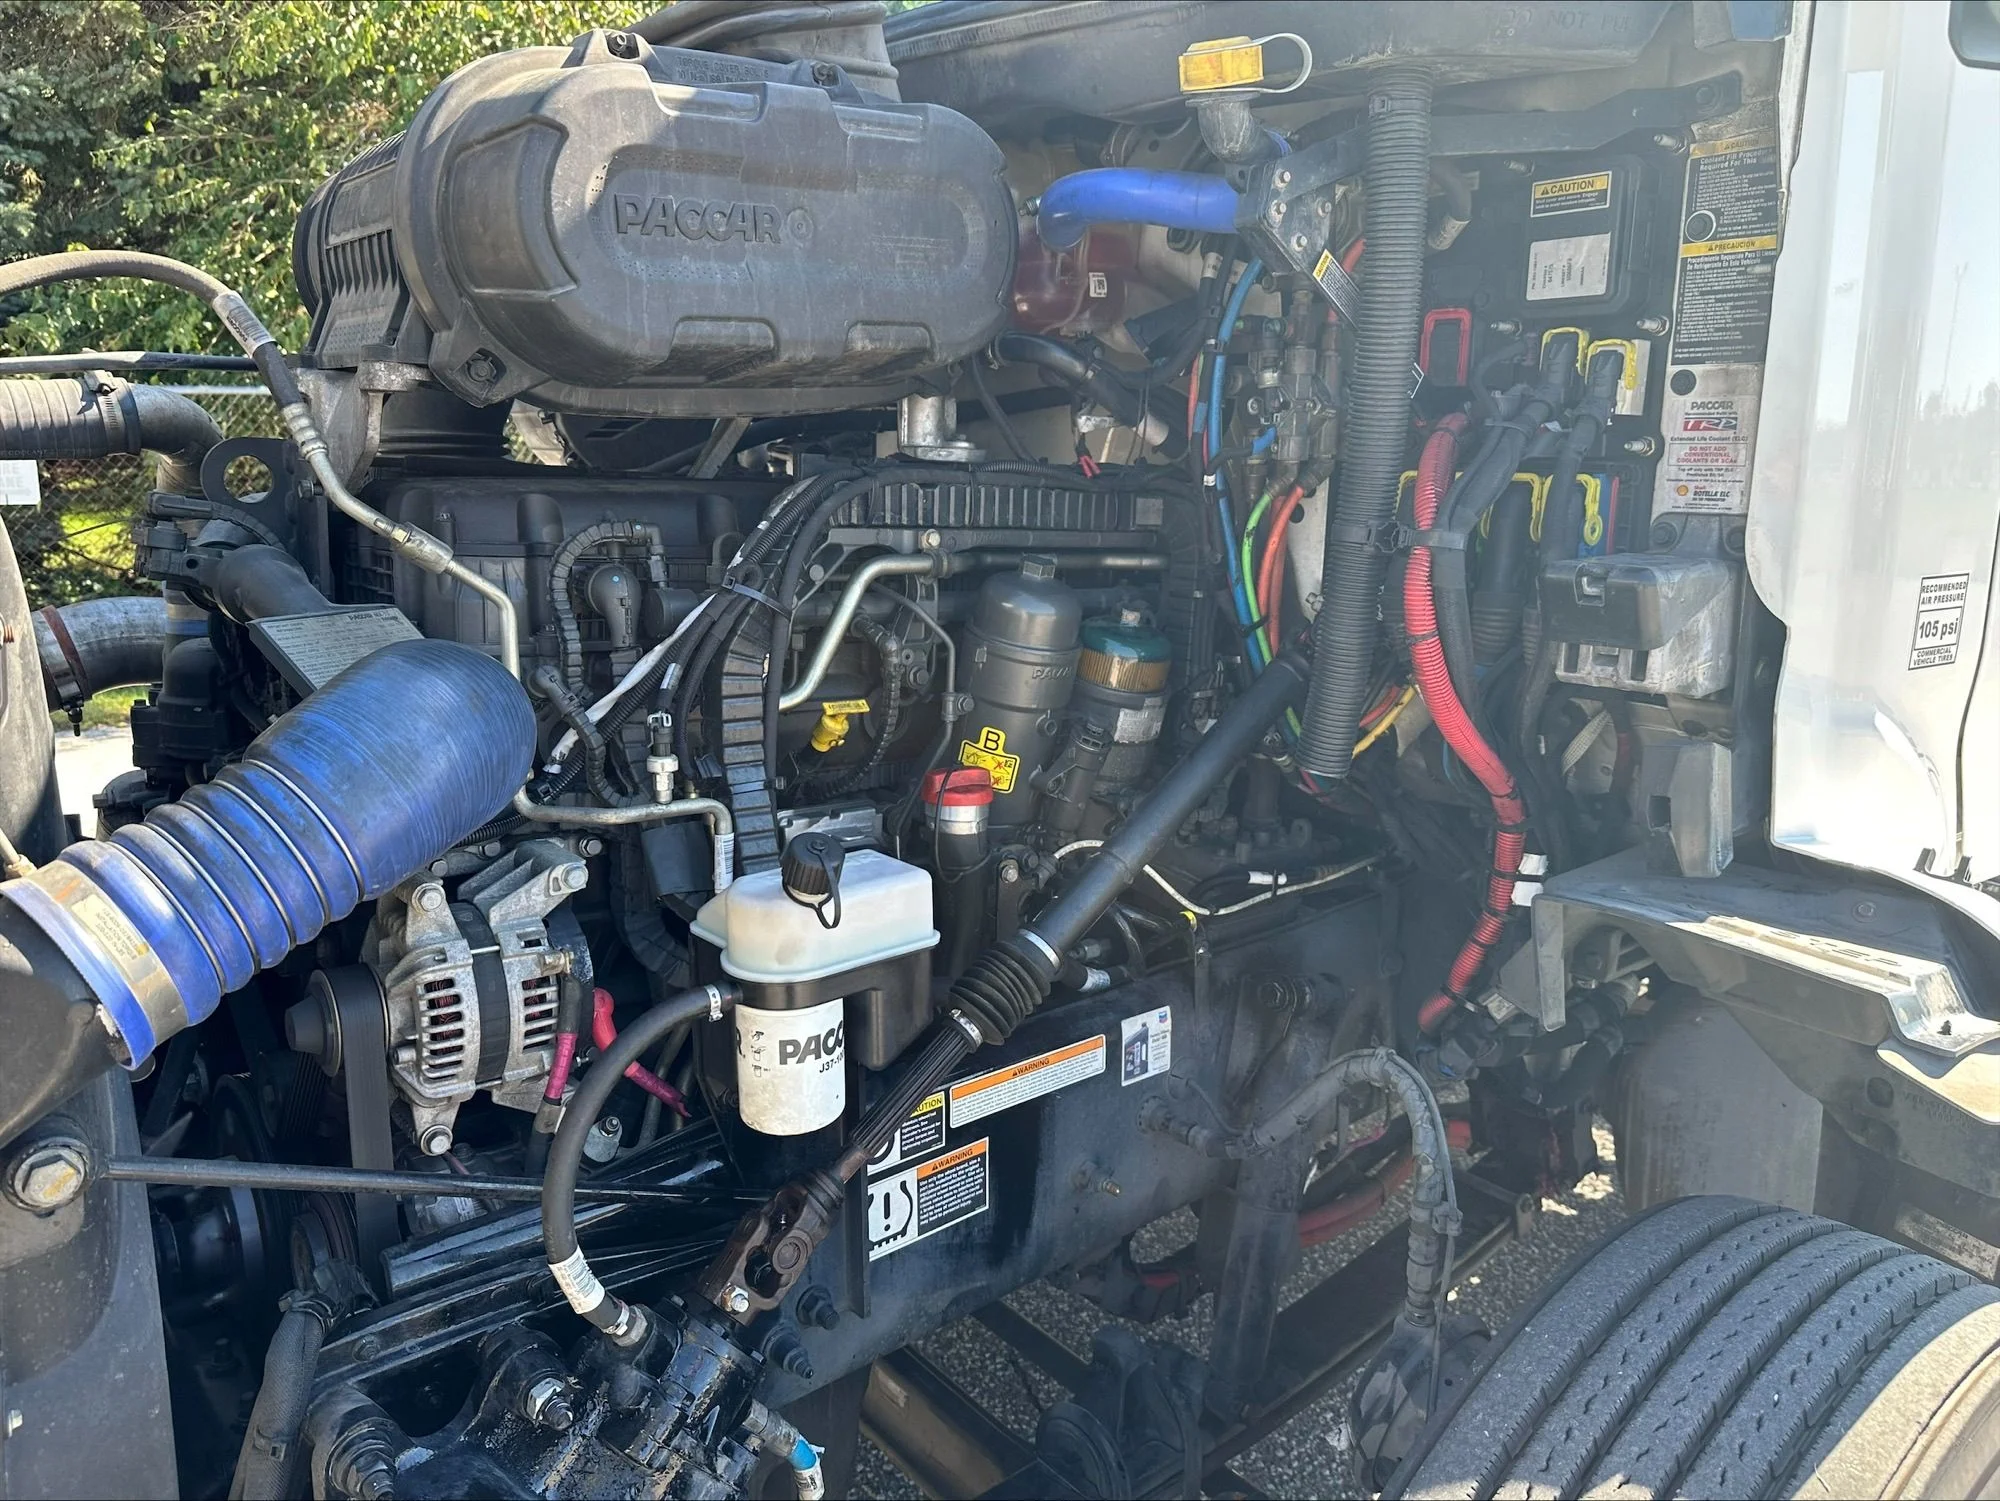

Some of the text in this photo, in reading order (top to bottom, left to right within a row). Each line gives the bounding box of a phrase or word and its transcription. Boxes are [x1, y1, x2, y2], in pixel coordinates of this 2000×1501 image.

[1550, 179, 1594, 194] CAUTION
[613, 193, 781, 244] PACCAR
[1690, 400, 1734, 410] PACCAR
[1921, 581, 1968, 593] RECOMMENDED
[1921, 593, 1964, 605] AIR PRESSURE
[1919, 618, 1959, 640] 105 psi
[1913, 653, 1953, 666] VEHICLE TIRES
[1917, 647, 1952, 658] COMMERCIAL
[984, 730, 1000, 751] B
[1018, 1058, 1049, 1075] WARNING
[911, 1098, 942, 1113] UTION
[938, 1149, 973, 1168] WARNING
